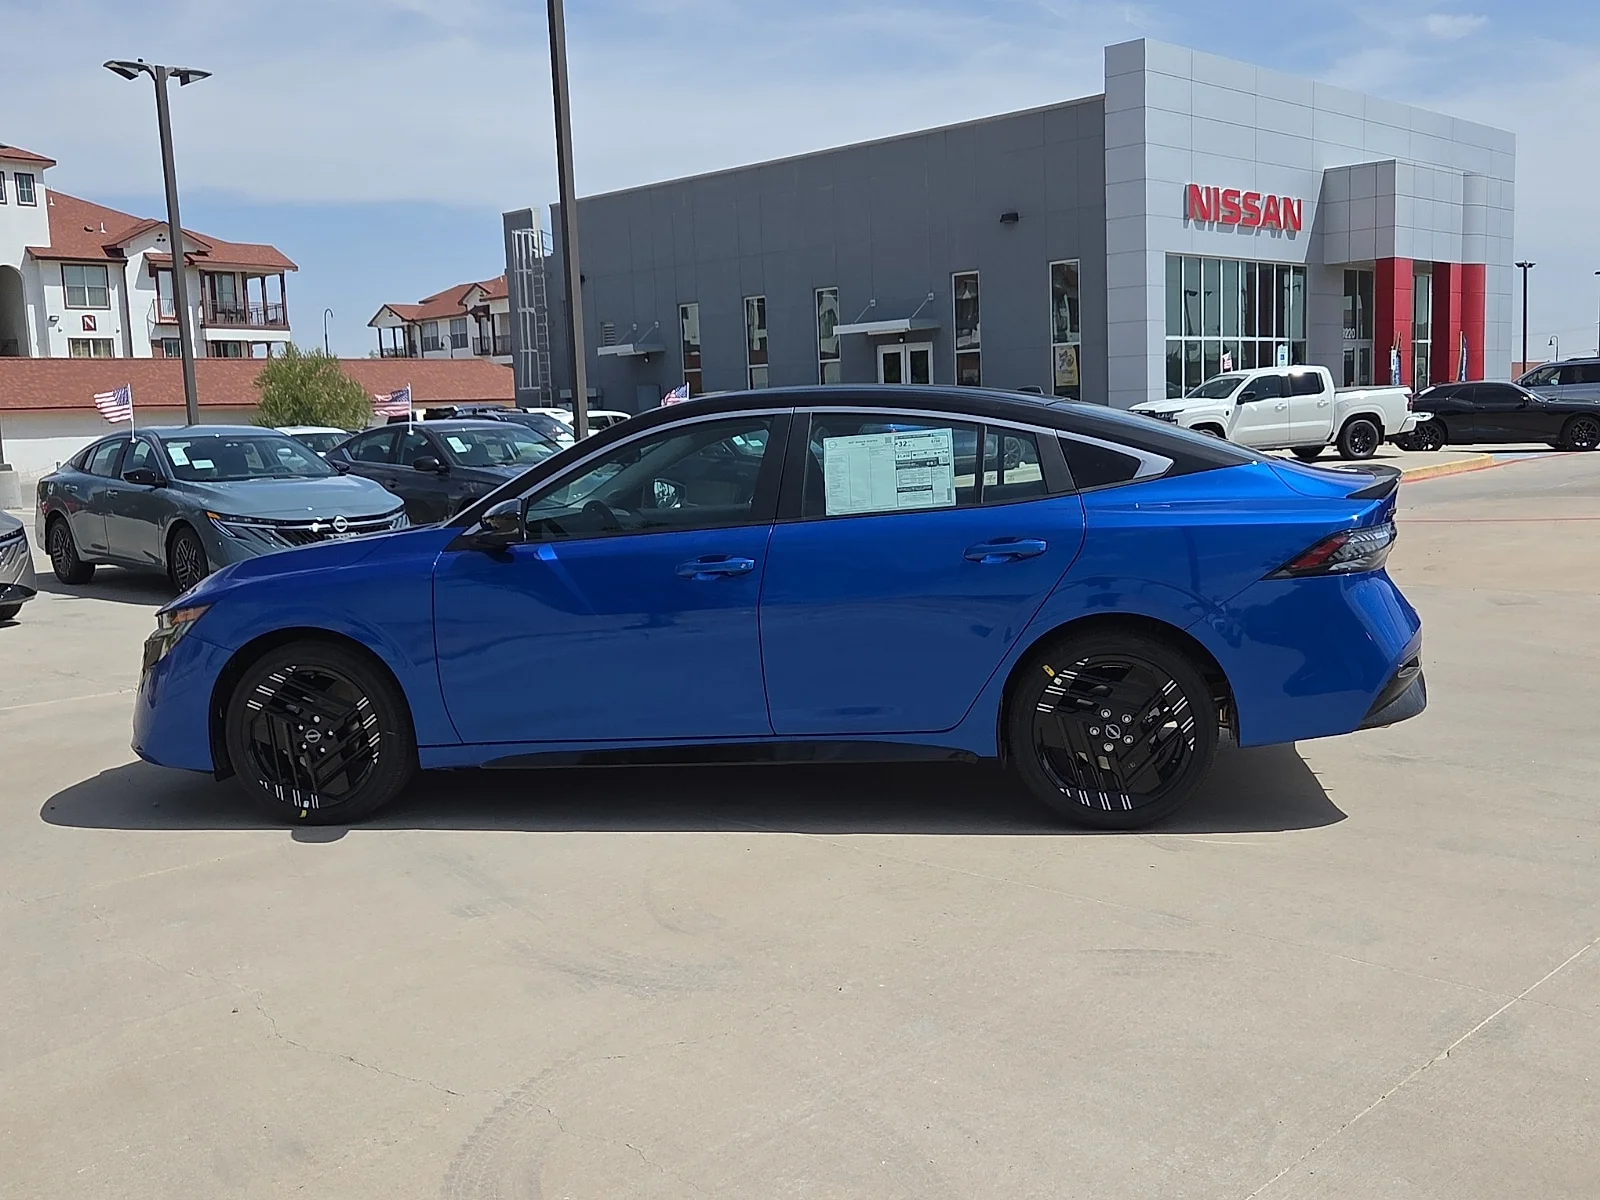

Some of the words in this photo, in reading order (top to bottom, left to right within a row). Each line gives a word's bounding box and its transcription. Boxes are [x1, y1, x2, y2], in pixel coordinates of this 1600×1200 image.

[1187, 183, 1302, 232] NISSAN
[83, 316, 95, 330] N
[898, 440, 908, 448] 32
